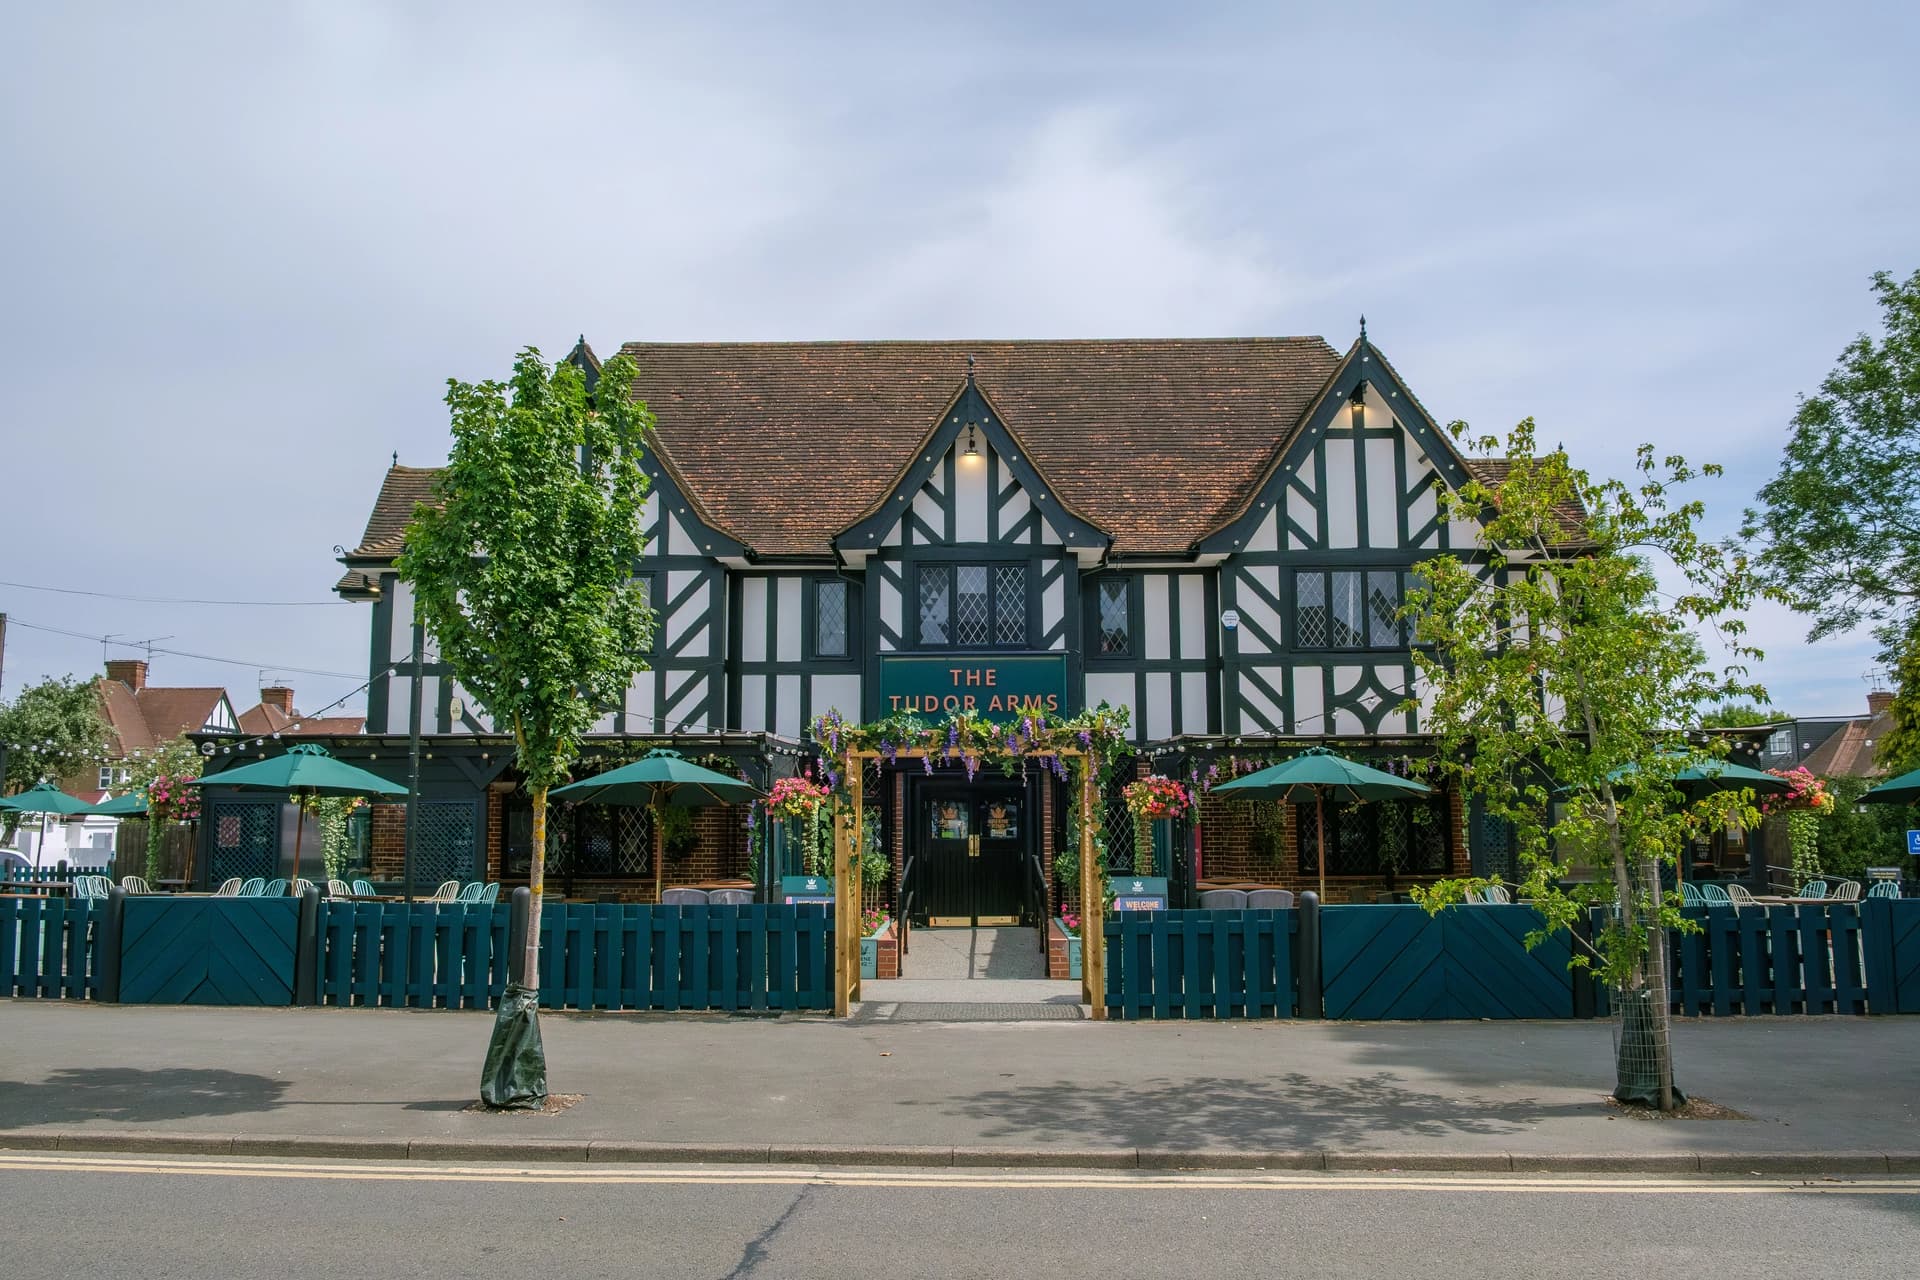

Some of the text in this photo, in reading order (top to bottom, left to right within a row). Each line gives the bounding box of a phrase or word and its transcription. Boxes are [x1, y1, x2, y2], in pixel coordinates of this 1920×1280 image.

[949, 669, 996, 686] THE
[889, 694, 1058, 712] TUDOR ARMS
[1125, 900, 1159, 909] WELCOME
